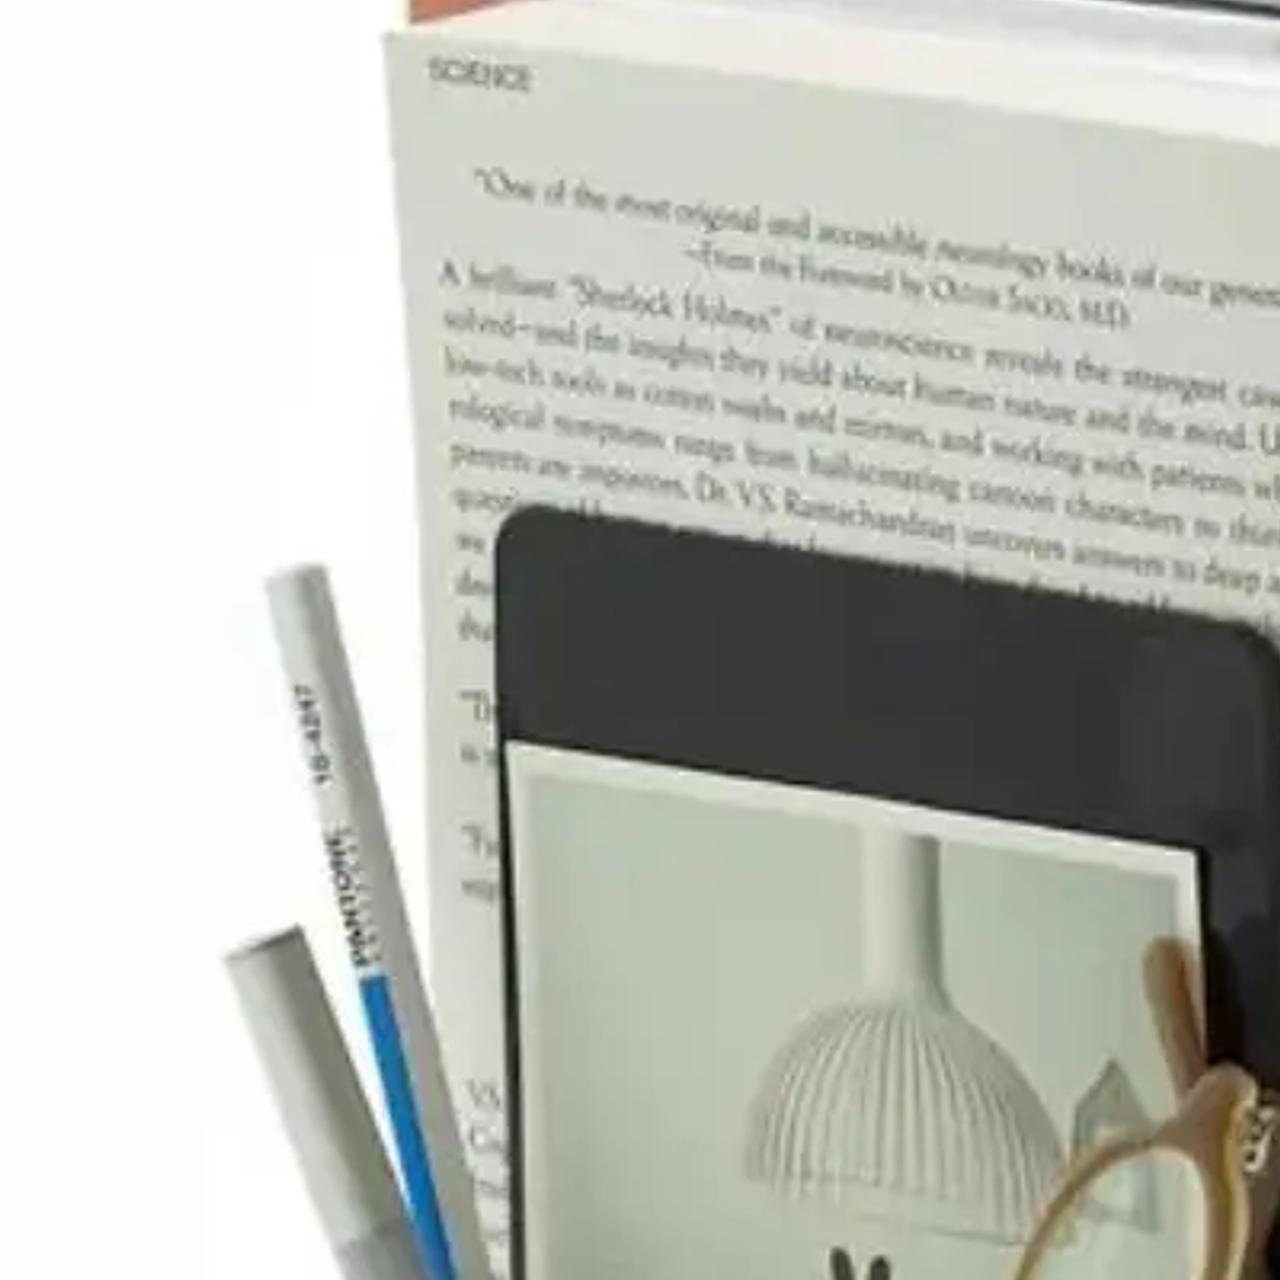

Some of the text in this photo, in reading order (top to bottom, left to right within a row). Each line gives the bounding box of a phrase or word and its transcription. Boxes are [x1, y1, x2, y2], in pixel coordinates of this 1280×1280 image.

[428, 56, 533, 93] SCIENCE
[543, 174, 565, 206] of
[573, 178, 608, 212] the
[616, 193, 670, 221] most
[674, 199, 760, 234] original
[767, 208, 810, 241] and
[817, 222, 924, 257] accessible
[935, 237, 1046, 281] neurology
[1056, 245, 1125, 286] books
[1131, 258, 1155, 290] of
[436, 253, 461, 285] A
[468, 258, 555, 299] brilliant
[789, 308, 815, 338] of
[825, 324, 972, 361] neuroscience
[985, 343, 1061, 375] reveals
[1074, 349, 1108, 382] the
[1123, 364, 1226, 405] strangest
[584, 323, 621, 354] the
[627, 333, 714, 371] insights
[720, 343, 768, 384] they
[778, 356, 832, 388] yield
[843, 363, 907, 398] about
[914, 372, 996, 412] human
[1004, 394, 1076, 424] nature
[1085, 402, 1130, 432] and
[1136, 406, 1174, 439] the
[550, 365, 607, 396] tools
[613, 380, 637, 401] as
[642, 384, 717, 413] cotton
[794, 402, 837, 432] and
[941, 425, 985, 455] and
[989, 435, 1083, 478] working
[1090, 450, 1145, 480] with
[1151, 462, 1246, 496] patients
[676, 433, 735, 466] range
[743, 433, 797, 470] from
[807, 444, 962, 504] hallucinating
[968, 479, 1056, 511] cartoon
[1065, 486, 1185, 532] characters
[1203, 552, 1260, 597] deep
[325, 828, 371, 968] PANTONE
